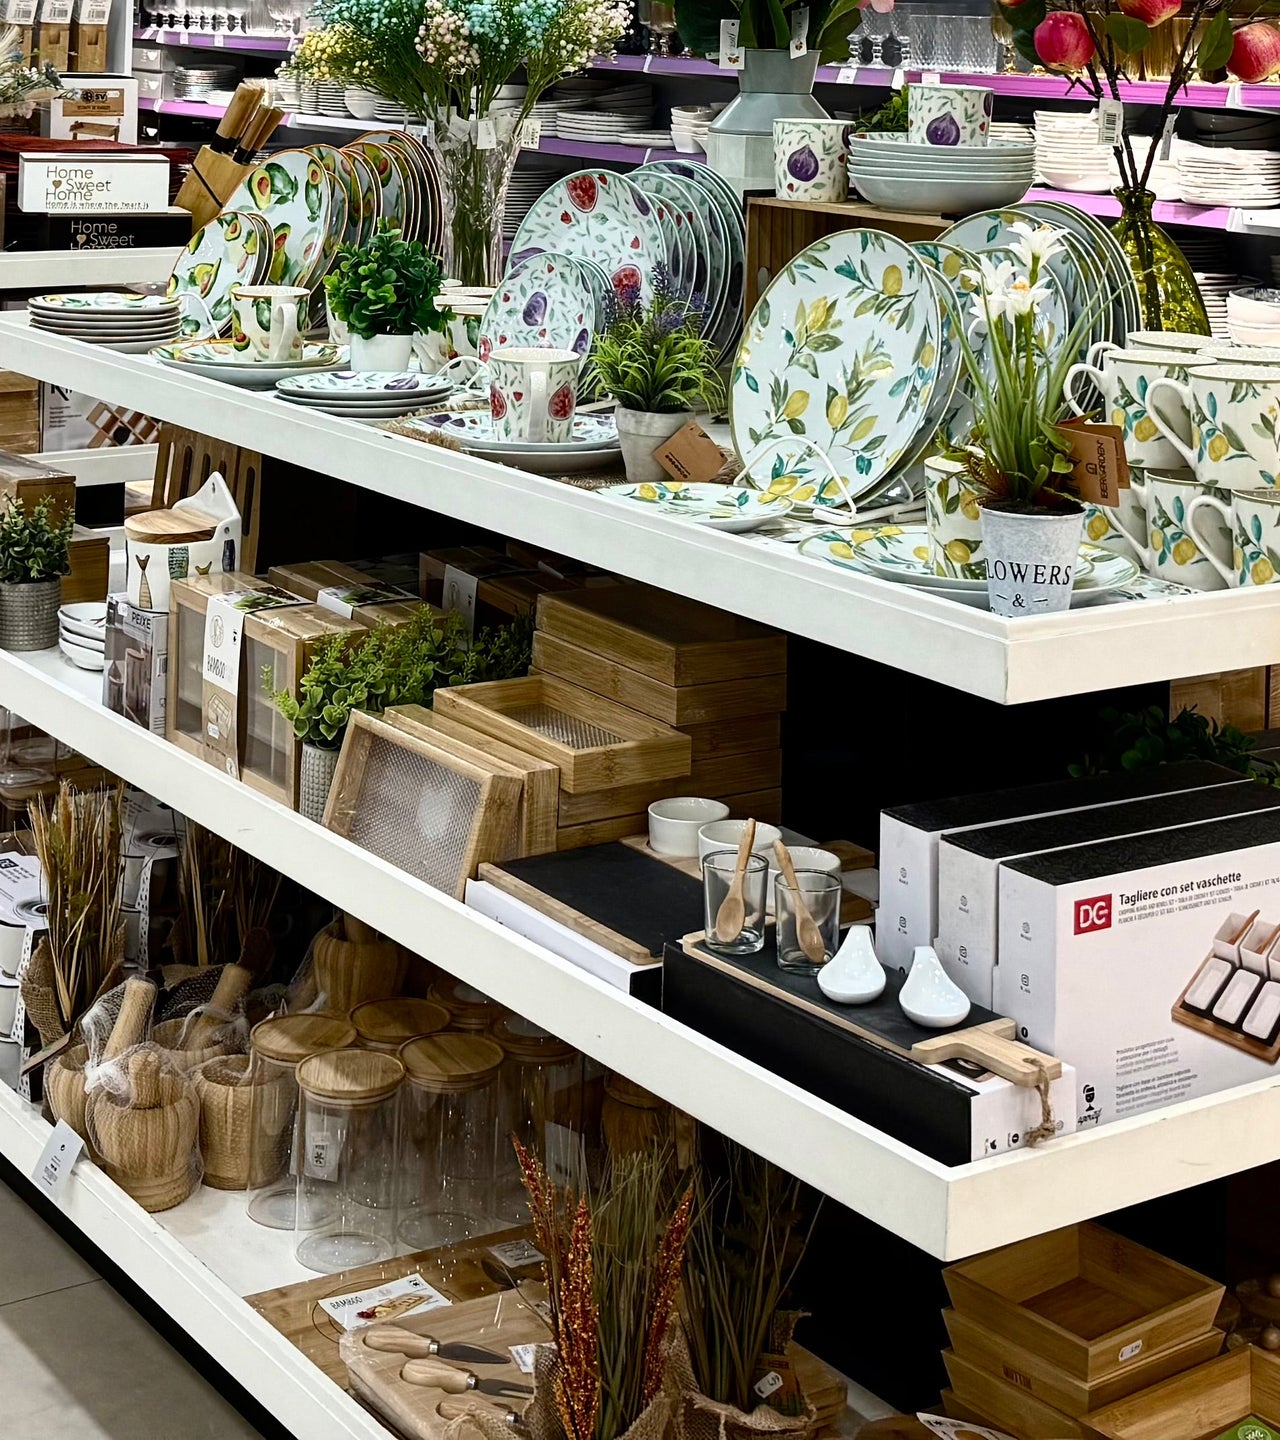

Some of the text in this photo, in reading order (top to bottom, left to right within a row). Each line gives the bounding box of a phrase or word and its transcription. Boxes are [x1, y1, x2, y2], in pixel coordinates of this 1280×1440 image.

[46, 165, 94, 179] Home
[65, 178, 112, 192] Sweet
[45, 187, 93, 201] Home
[71, 220, 118, 234] Home
[89, 232, 135, 246] Sweet
[985, 558, 1072, 586] LOWERS
[1012, 593, 1026, 608] &
[131, 611, 151, 631] PEIXE
[207, 653, 226, 679] BAMBOO
[1119, 871, 1242, 907] Tagliere con set vaschette
[328, 1295, 363, 1310] BAMBOO
